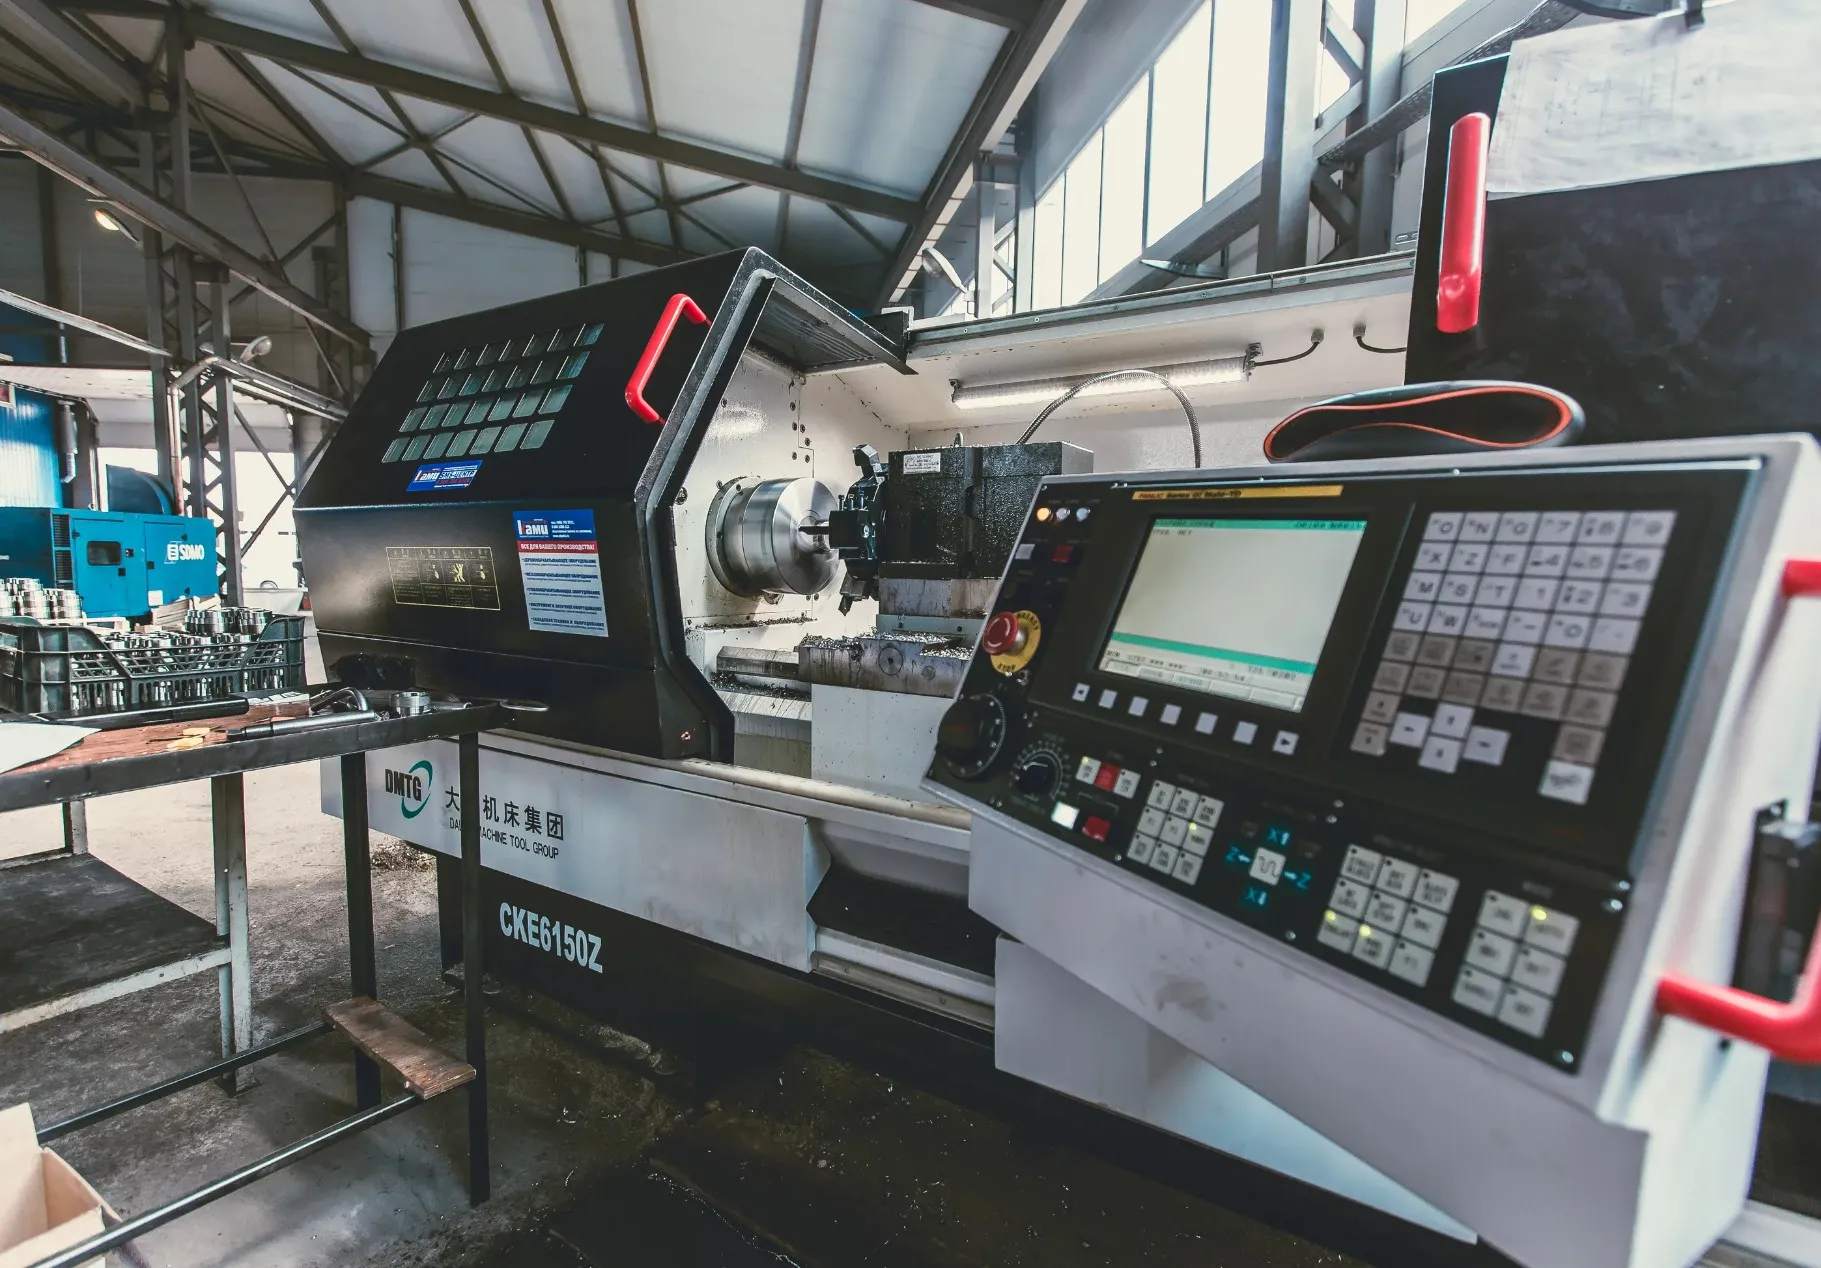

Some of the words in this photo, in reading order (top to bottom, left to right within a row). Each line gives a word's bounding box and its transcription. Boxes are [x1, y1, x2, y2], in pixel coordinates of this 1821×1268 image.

[179, 544, 205, 560] SDMO
[384, 768, 422, 802] DMTG
[445, 785, 564, 840] 大机床集团
[480, 826, 507, 845] ACHINE
[510, 834, 530, 851] TOOL
[533, 842, 559, 859] GROUP
[499, 902, 603, 973] CKE6150Z
